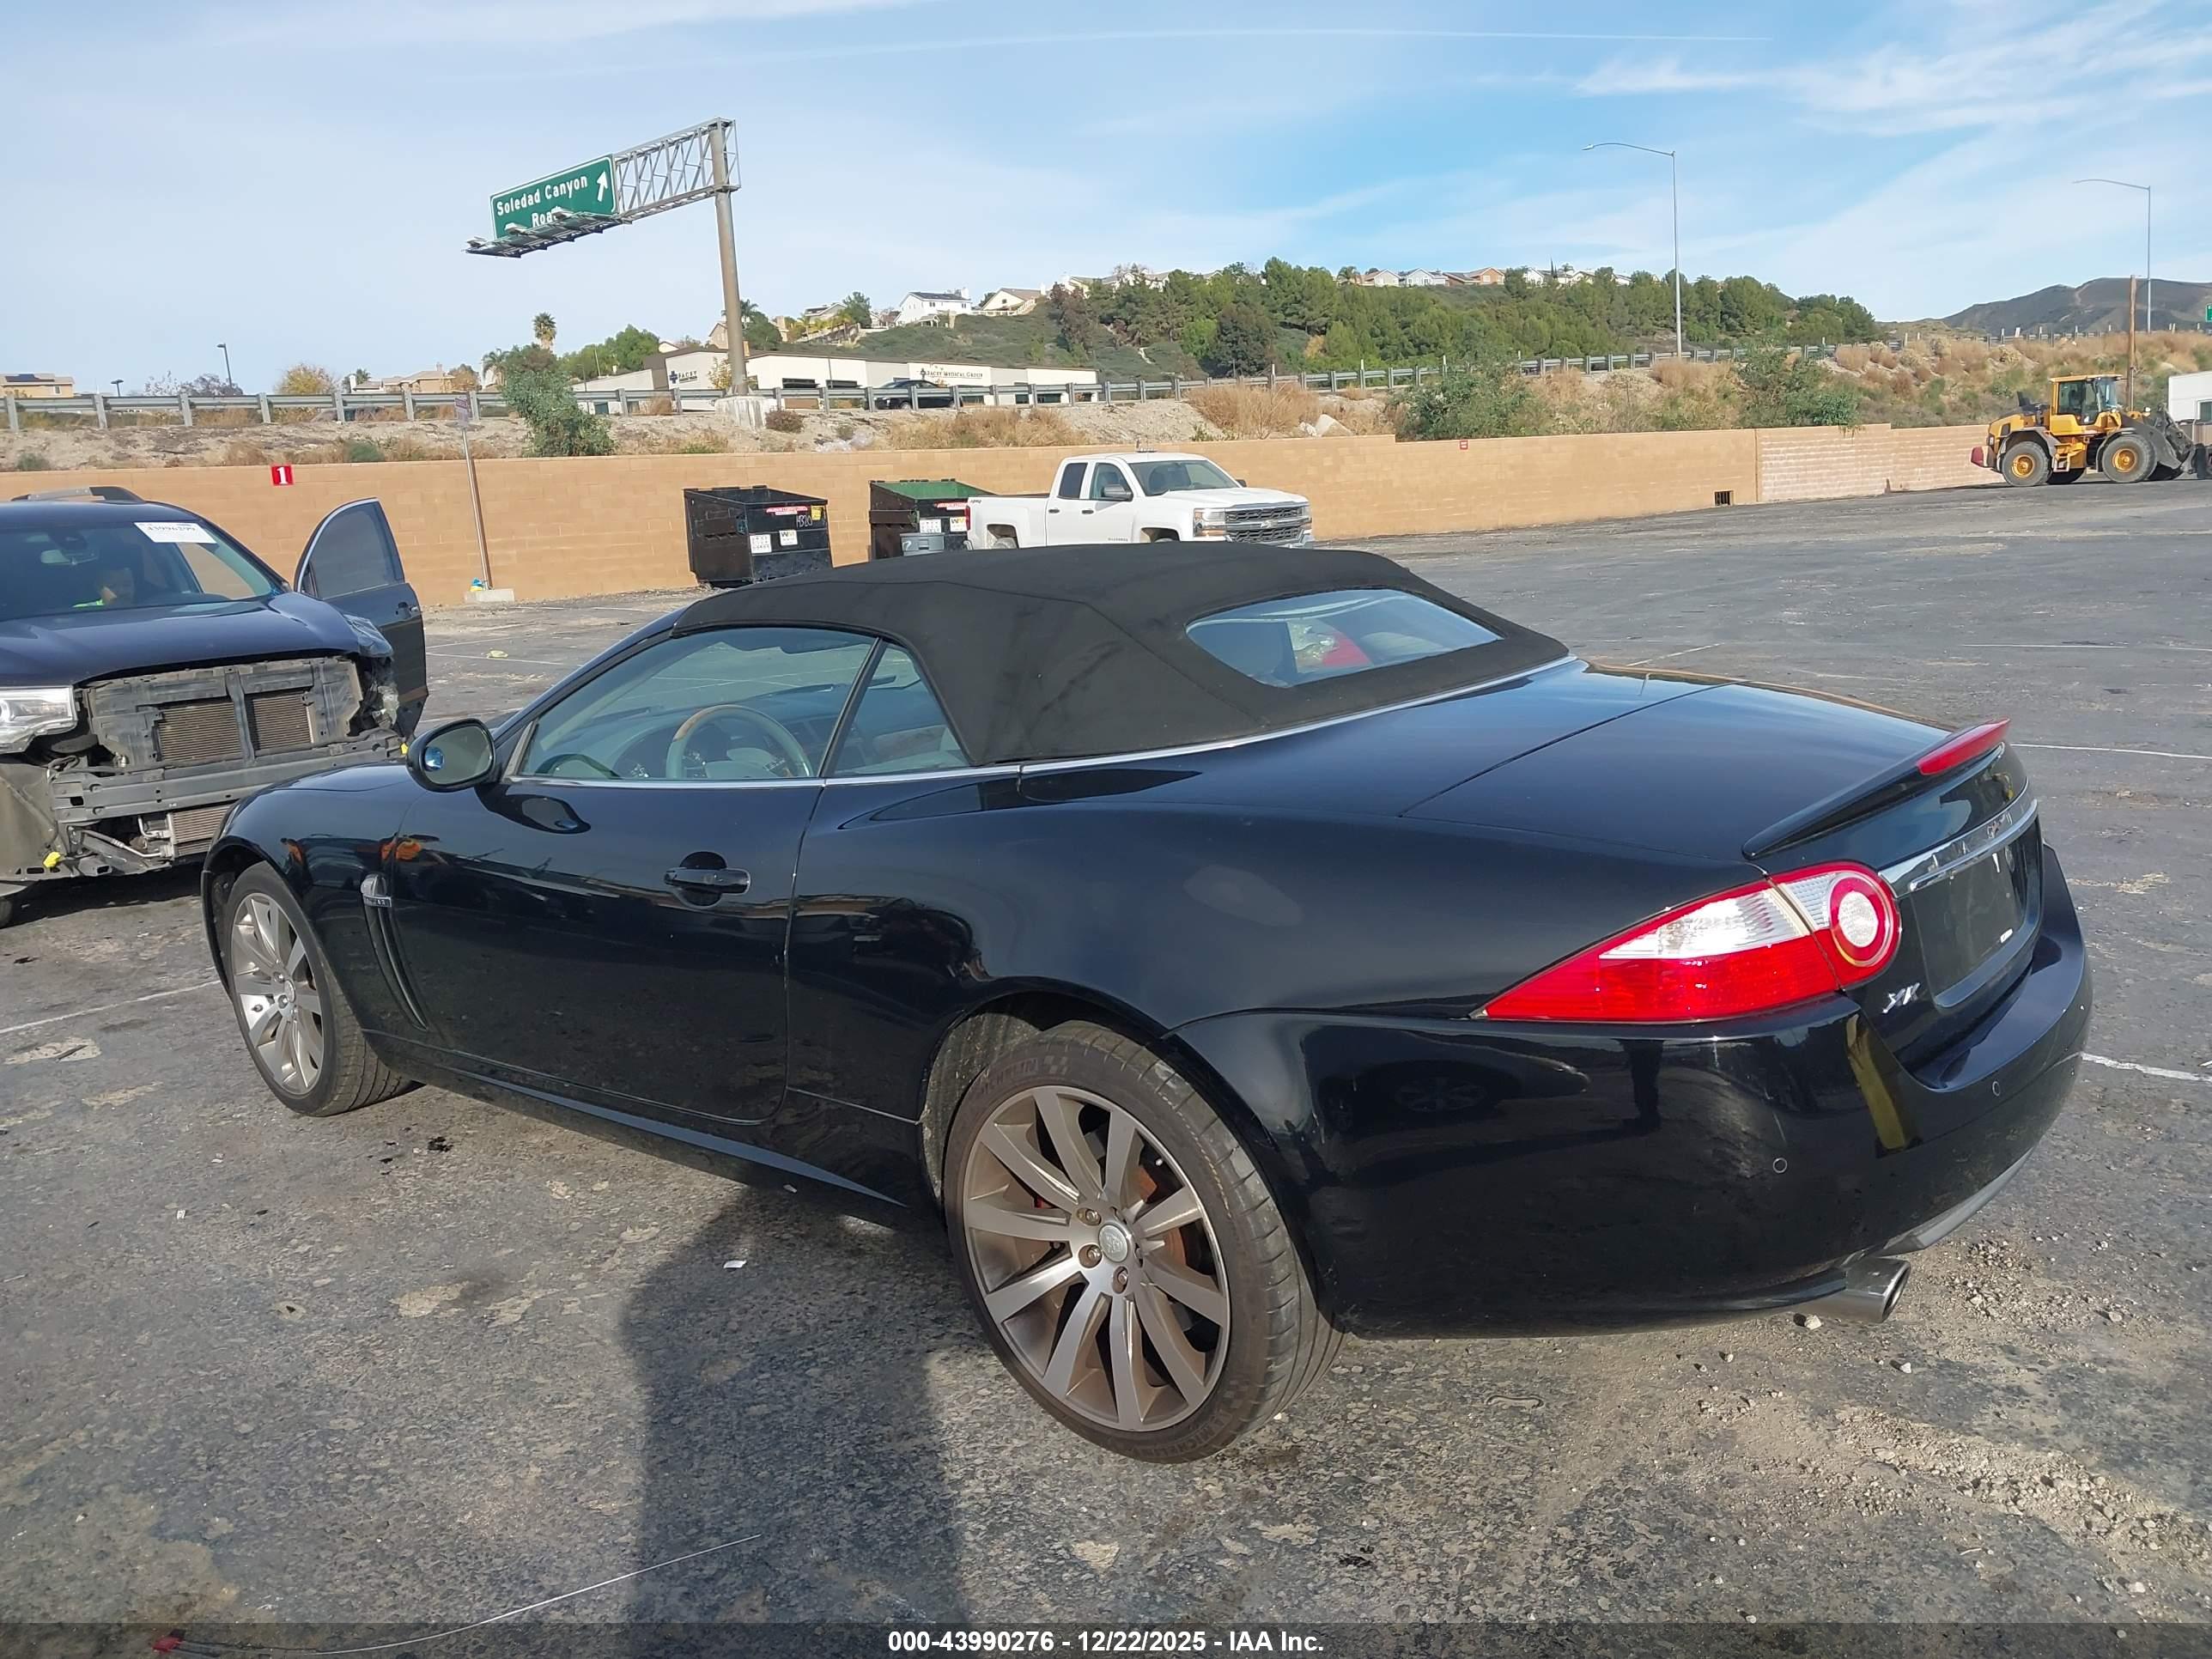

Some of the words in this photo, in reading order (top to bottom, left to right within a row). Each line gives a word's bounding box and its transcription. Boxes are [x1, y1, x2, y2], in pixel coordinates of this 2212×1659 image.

[496, 188, 541, 216] Soledad
[544, 175, 588, 199] Canyon
[531, 211, 558, 228] Roa
[276, 466, 289, 484] 1
